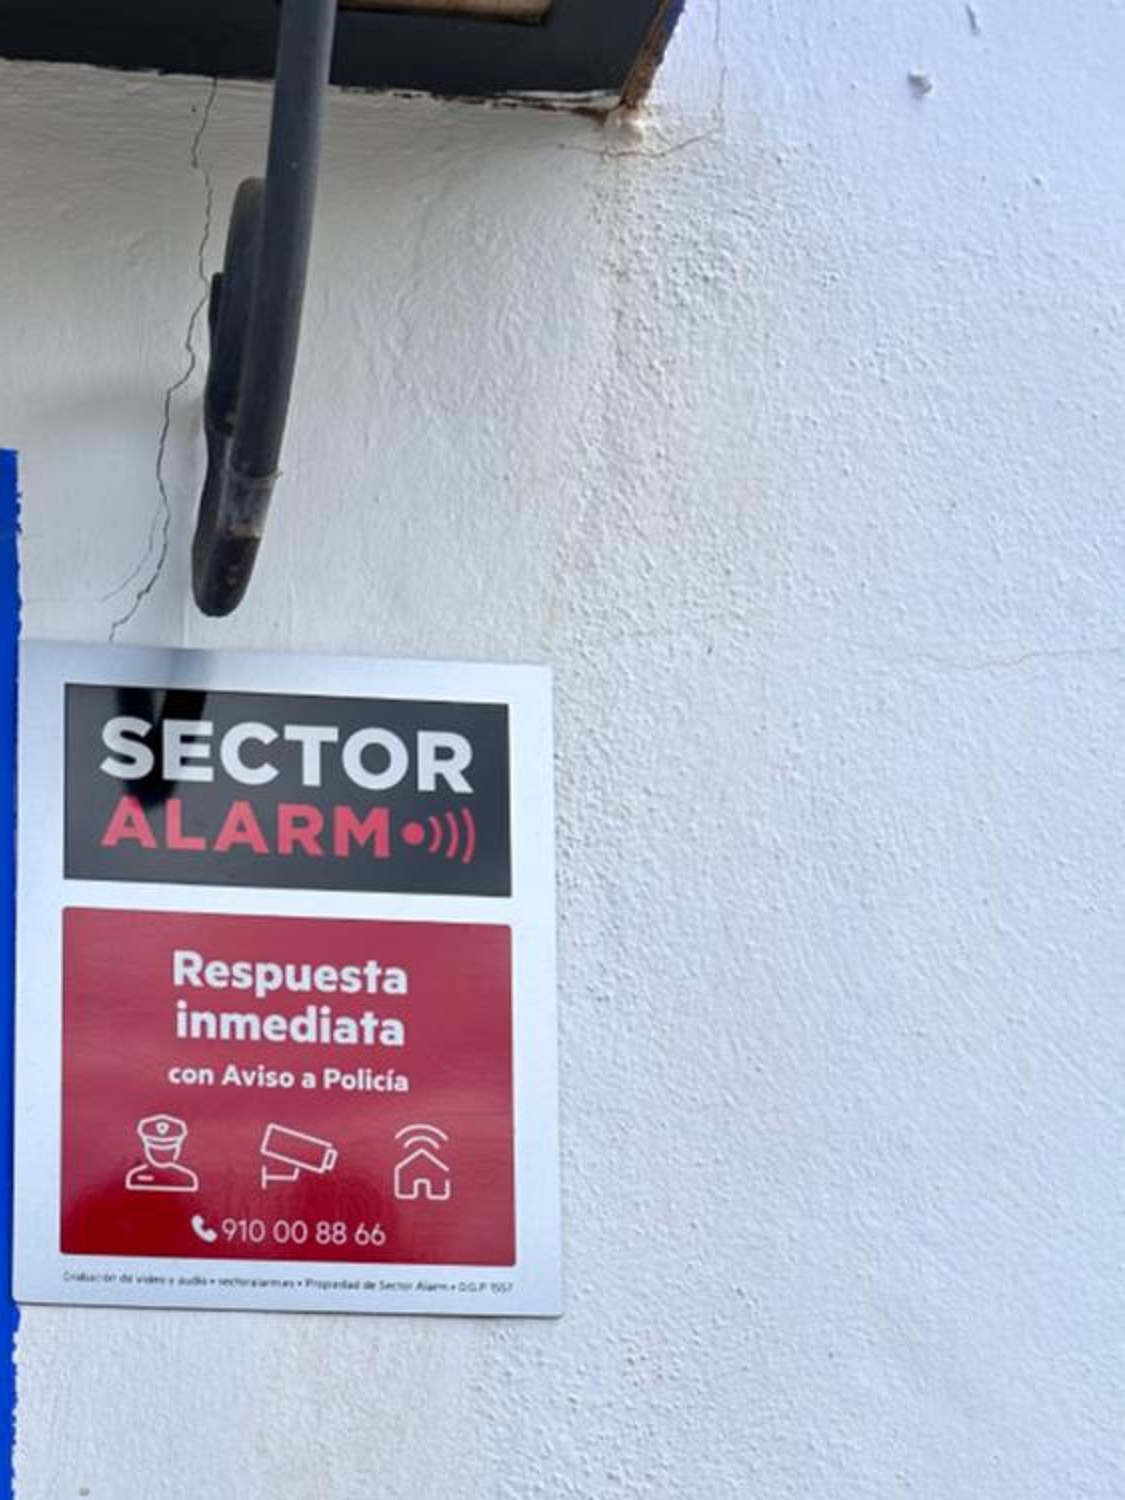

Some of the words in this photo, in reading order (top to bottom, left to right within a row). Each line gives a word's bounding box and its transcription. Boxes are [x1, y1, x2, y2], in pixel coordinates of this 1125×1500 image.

[100, 716, 474, 794] SECTOR
[101, 796, 391, 858] ALARM
[173, 949, 408, 998] Respuesta
[176, 1000, 405, 1046] inmediata
[168, 1067, 214, 1084] con
[222, 1064, 295, 1088] Aviso
[301, 1072, 316, 1089] a
[323, 1068, 409, 1092] Policía
[222, 1218, 266, 1244] 910
[273, 1220, 308, 1244] 00
[315, 1221, 347, 1245] 88
[354, 1222, 386, 1246] 66
